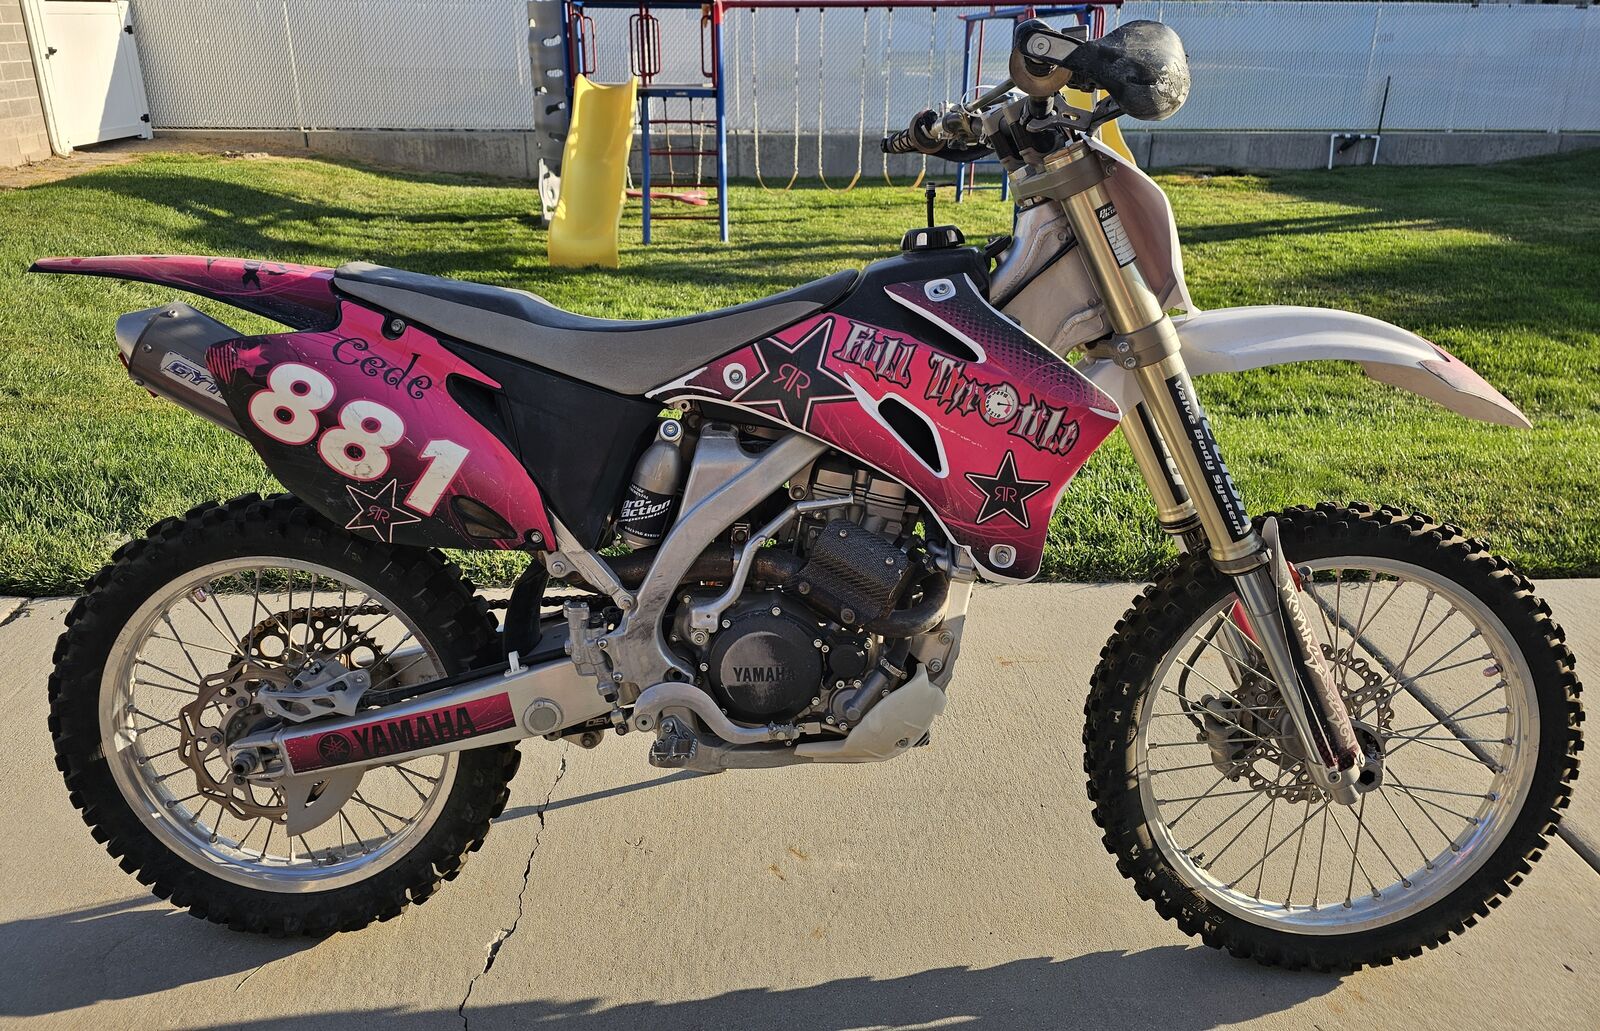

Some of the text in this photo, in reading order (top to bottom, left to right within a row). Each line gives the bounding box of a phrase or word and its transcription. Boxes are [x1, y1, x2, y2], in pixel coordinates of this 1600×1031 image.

[164, 362, 225, 399] GYT
[833, 320, 916, 388] Full
[249, 361, 470, 516] 881
[1173, 379, 1244, 536] Valve Body System
[732, 666, 796, 683] YAMAHA
[352, 707, 475, 756] YAMAHA
